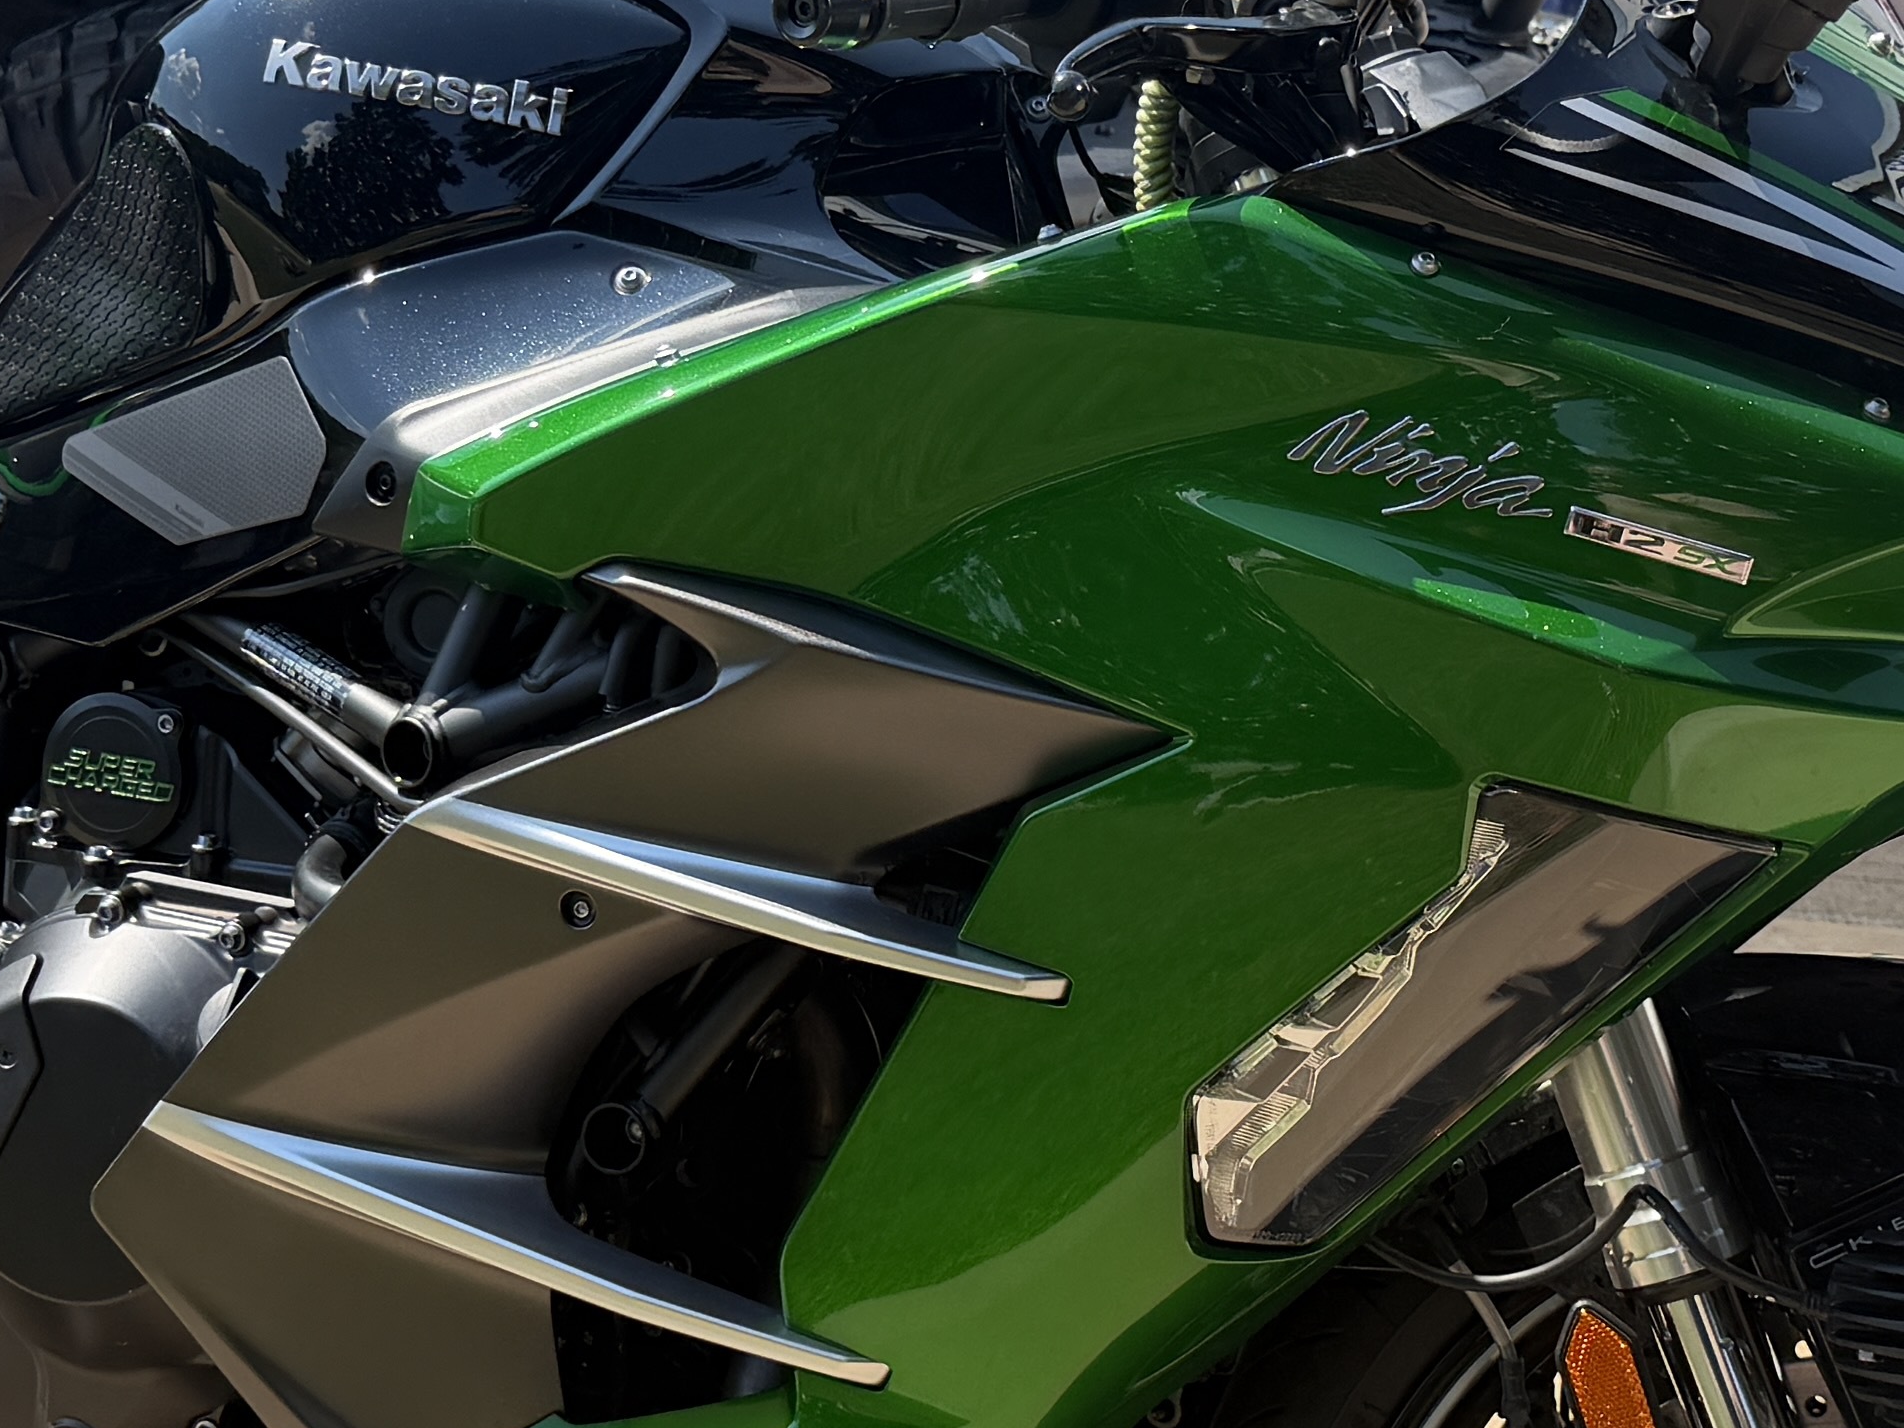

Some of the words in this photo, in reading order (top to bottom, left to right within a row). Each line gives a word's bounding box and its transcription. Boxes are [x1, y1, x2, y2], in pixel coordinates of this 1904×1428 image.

[262, 38, 573, 136] Kawasaki
[1287, 409, 1553, 517] Ninja
[47, 765, 175, 802] CHARGED
[64, 748, 156, 779] SUPER
